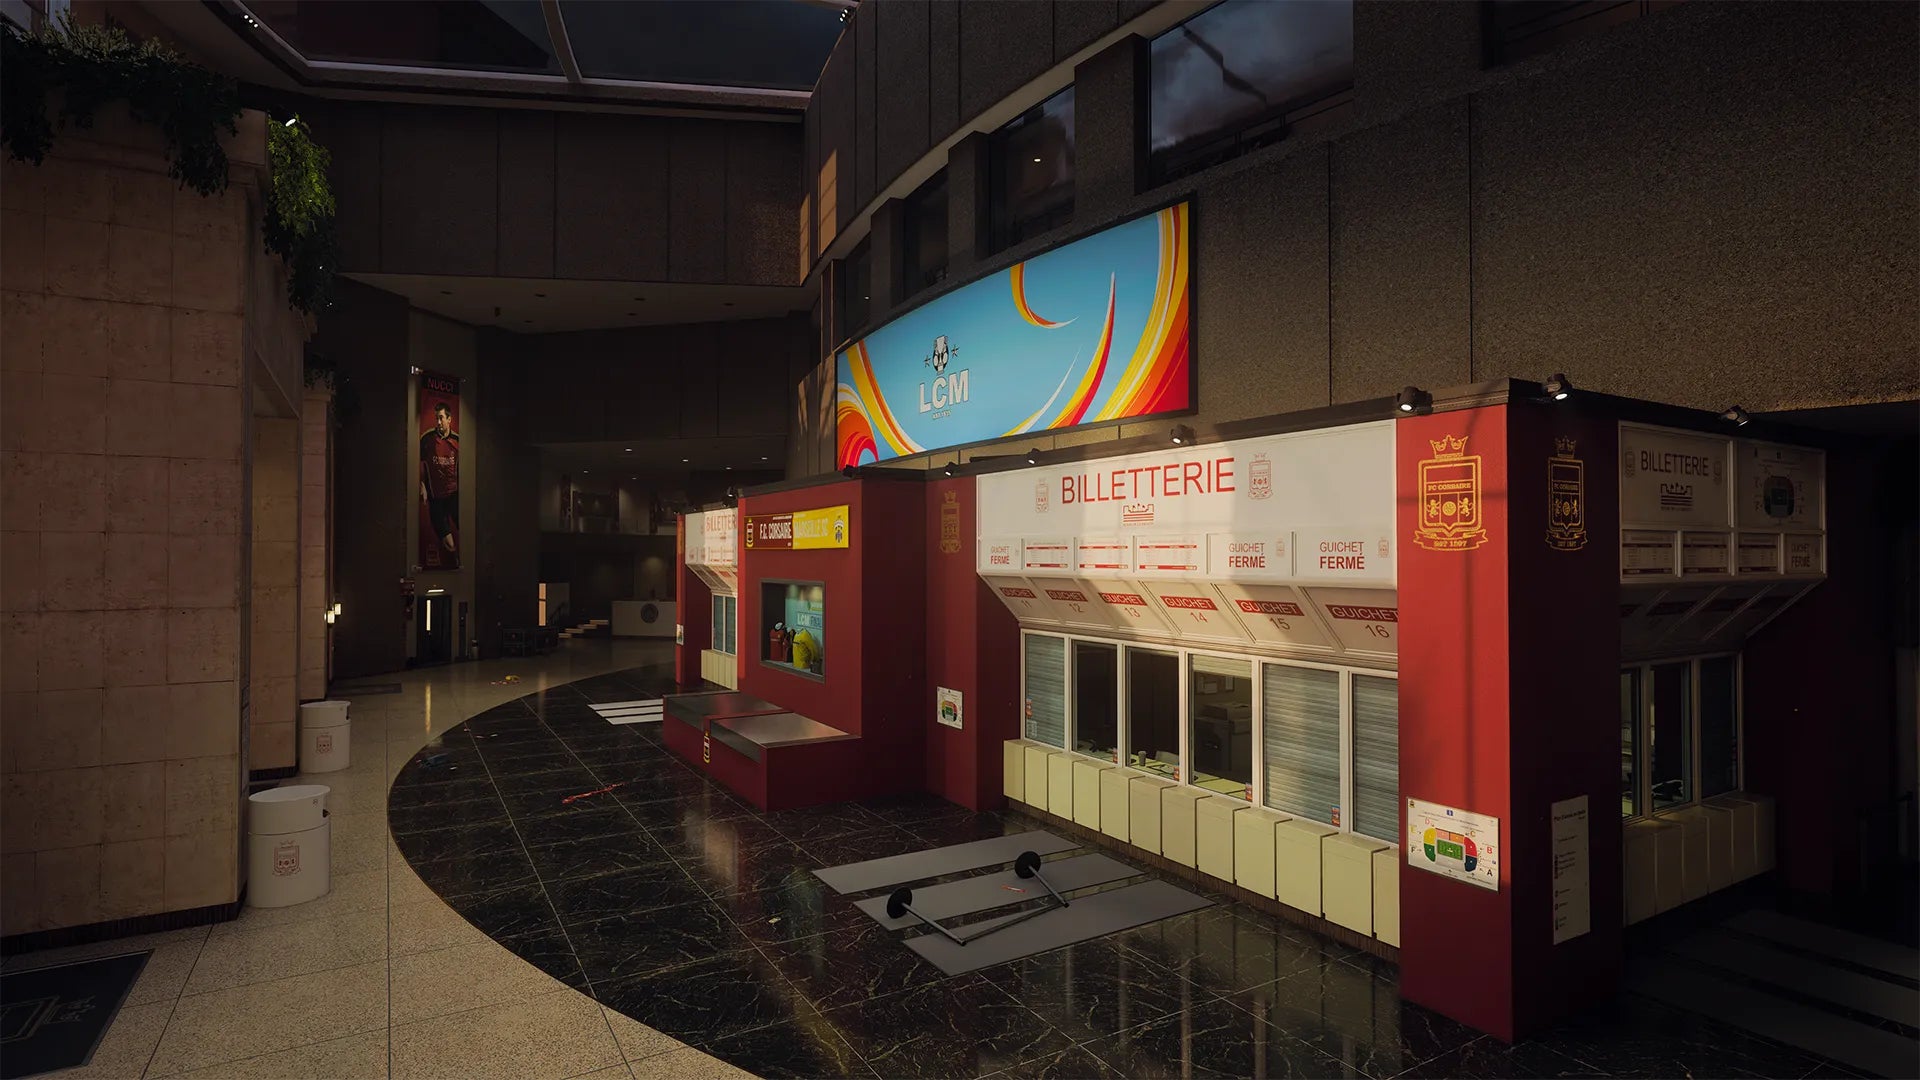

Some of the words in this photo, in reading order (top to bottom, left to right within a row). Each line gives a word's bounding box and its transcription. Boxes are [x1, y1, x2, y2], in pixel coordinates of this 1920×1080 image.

[919, 368, 969, 414] LCM
[1641, 450, 1709, 477] BILLETTERIE
[1062, 457, 1235, 504] BILLETTERIE
[1229, 542, 1265, 553] GUICHET
[1319, 541, 1364, 553] GUICHET
[1229, 553, 1265, 568] FERMÉ
[1319, 552, 1365, 570] FERMÉ
[1049, 590, 1084, 602] GUICHET
[1102, 593, 1144, 605] GUICHET
[1069, 603, 1084, 613] 12
[1164, 597, 1212, 609] GUICHET
[1240, 601, 1297, 615] GUICHET
[1124, 607, 1141, 617] 13
[1190, 612, 1208, 623] 14
[1332, 606, 1398, 621] GUICHET
[1269, 617, 1290, 631] 15
[1365, 624, 1390, 638] 16
[1486, 869, 1493, 877] A
